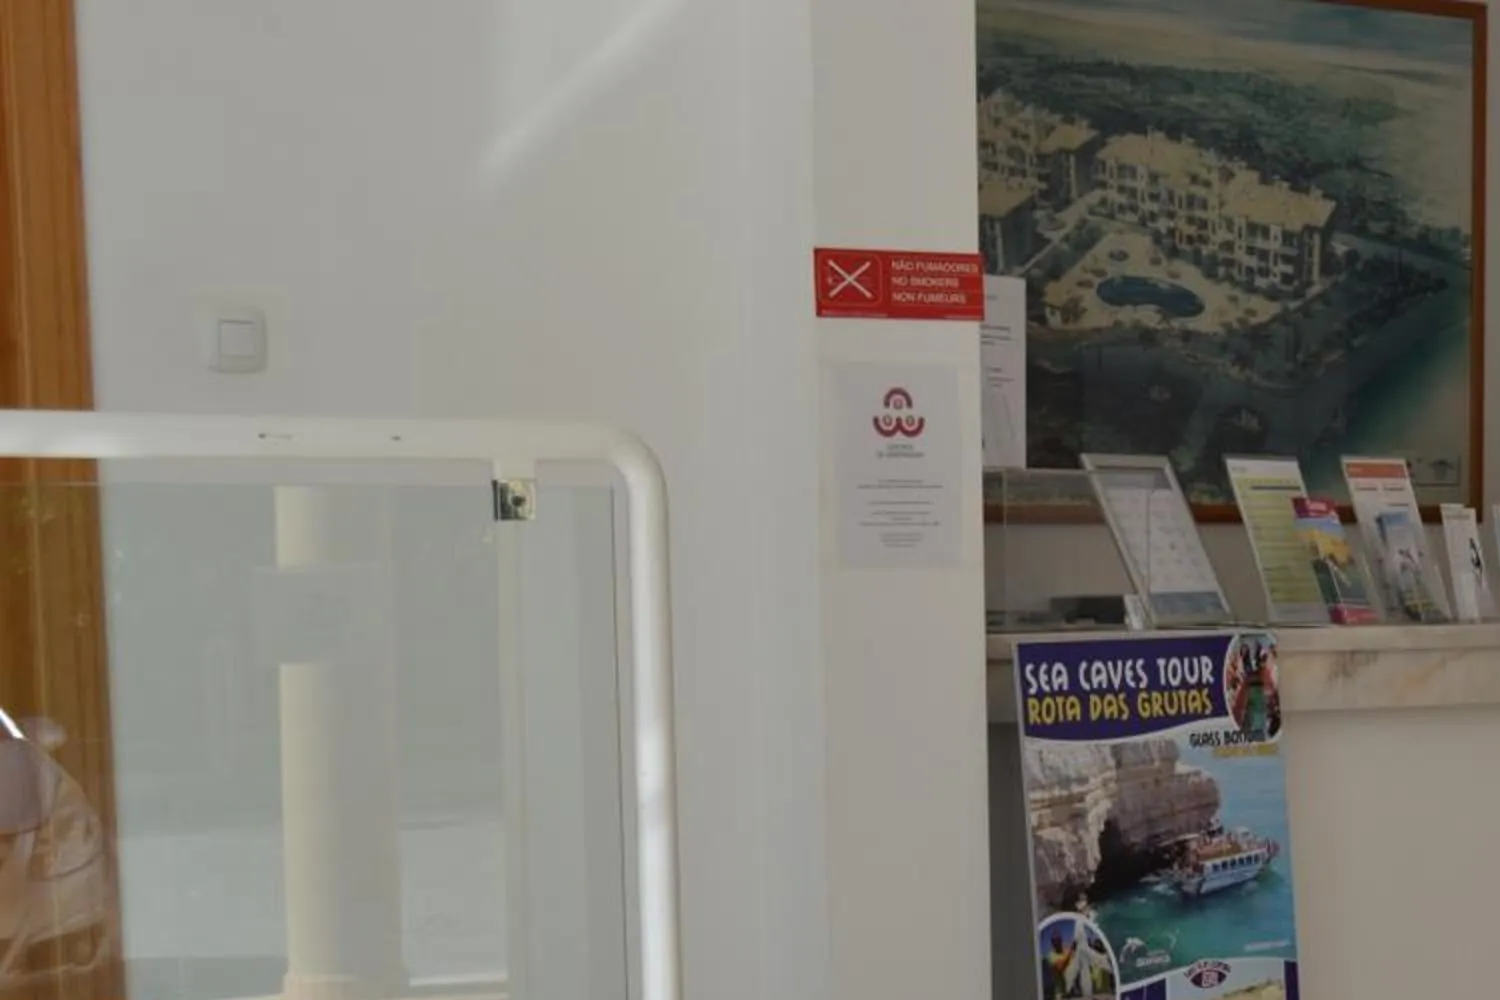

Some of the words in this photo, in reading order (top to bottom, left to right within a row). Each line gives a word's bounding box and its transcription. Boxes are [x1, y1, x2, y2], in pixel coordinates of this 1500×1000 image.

[891, 258, 914, 271] NÃO
[916, 260, 979, 274] FUMADORES
[891, 276, 908, 286] NO
[892, 291, 914, 303] NON
[1024, 662, 1069, 695] SEA
[1078, 657, 1148, 692] CAVES
[1156, 655, 1215, 687] TOUR
[1028, 694, 1082, 726] ROTA
[1089, 691, 1131, 722] DAS
[1136, 688, 1214, 719] GRUTAS
